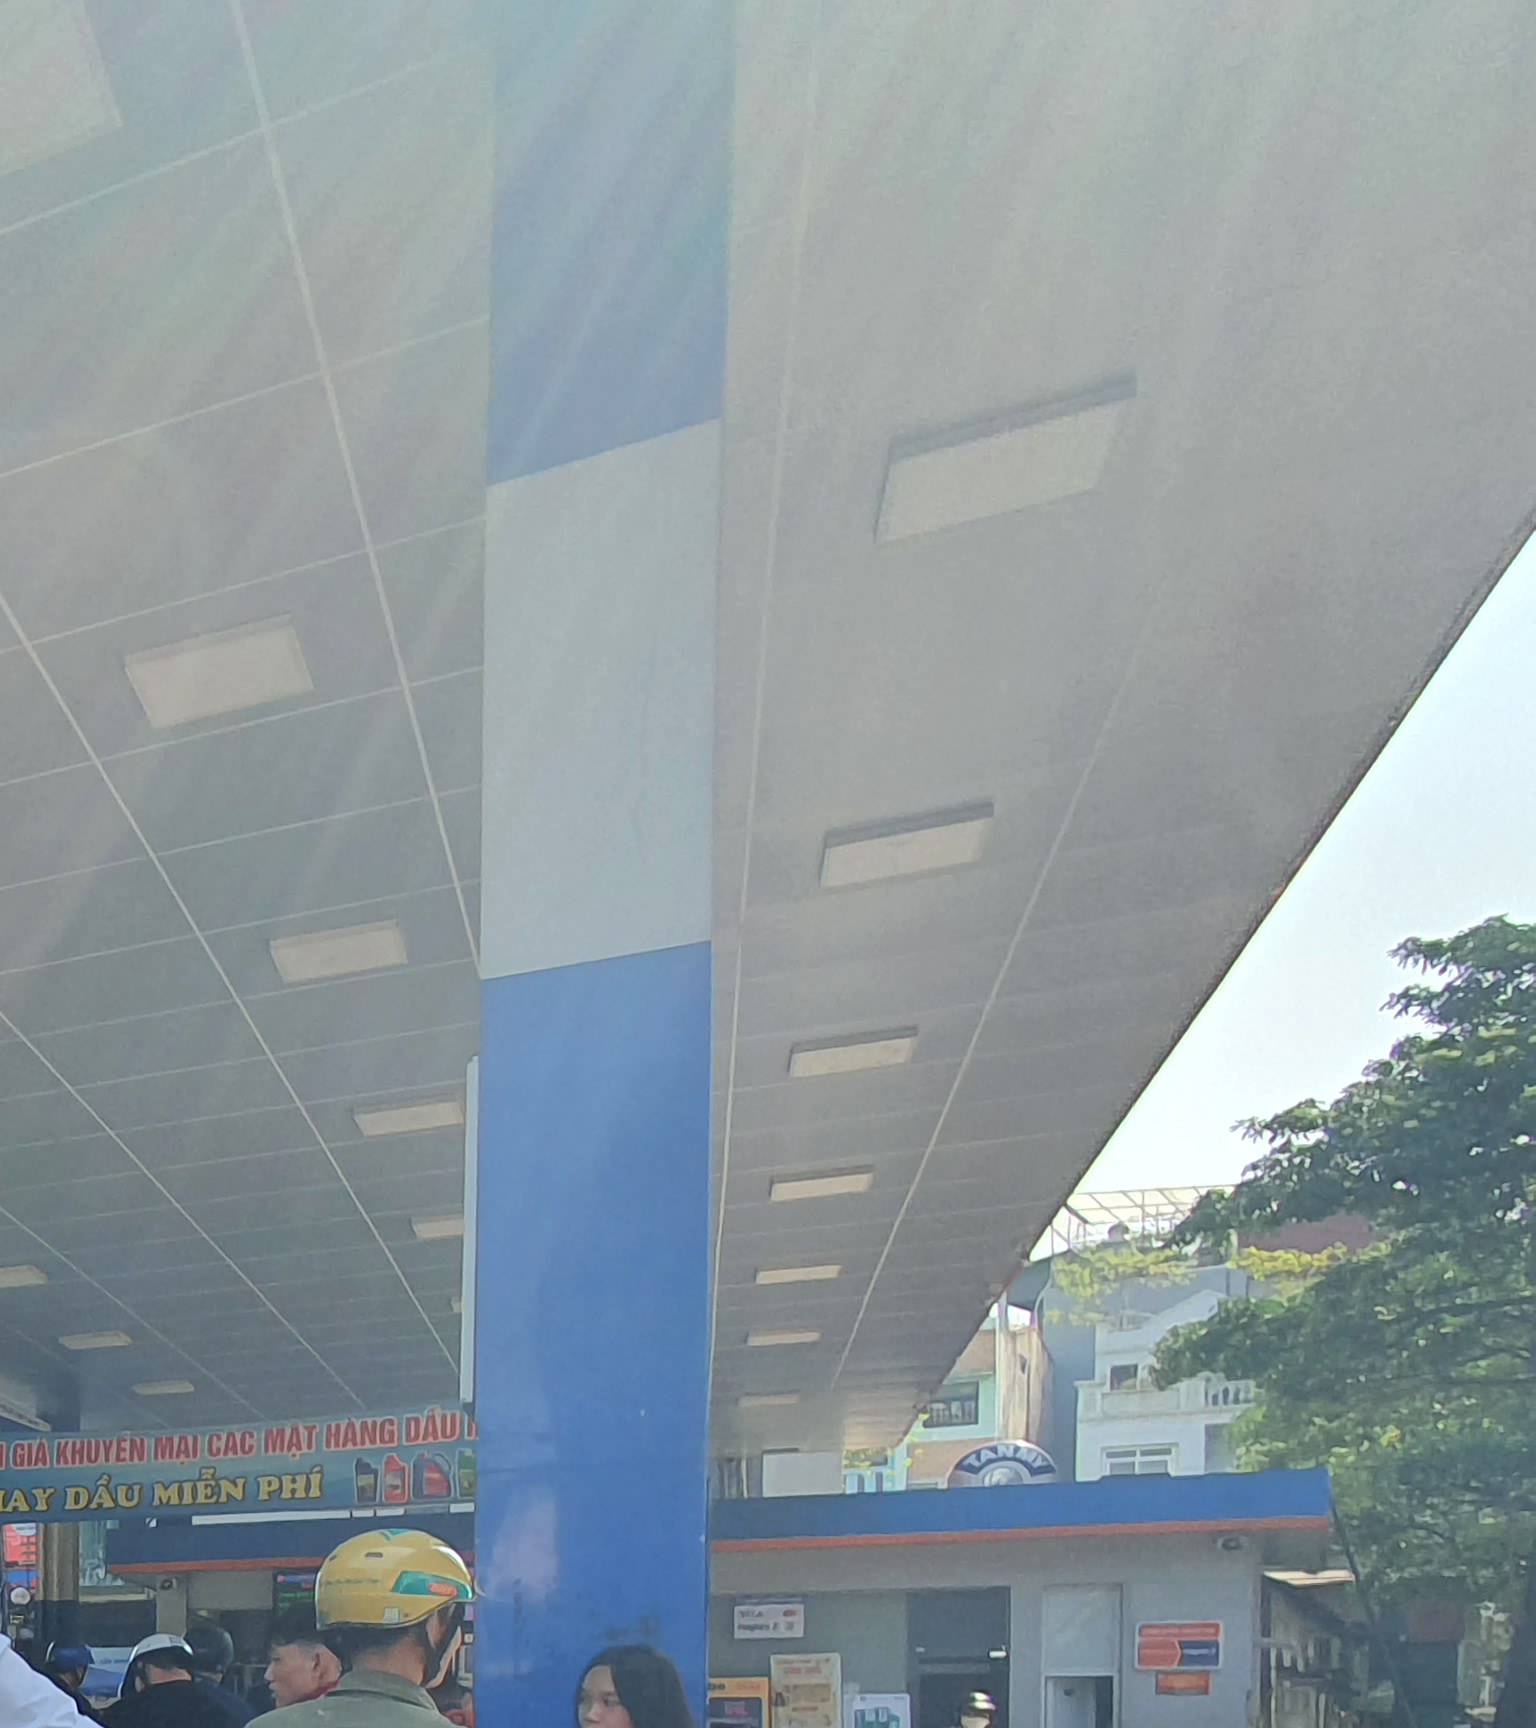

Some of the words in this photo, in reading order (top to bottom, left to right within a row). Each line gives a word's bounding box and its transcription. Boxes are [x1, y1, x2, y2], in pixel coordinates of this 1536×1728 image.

[11, 1437, 50, 1469] GIÁ
[55, 1431, 147, 1467] KHUYẾN
[153, 1434, 200, 1465] MẠI
[325, 1416, 398, 1450] HÀNG
[153, 1465, 246, 1507] MIỄN
[257, 1465, 324, 1500] PHÍ
